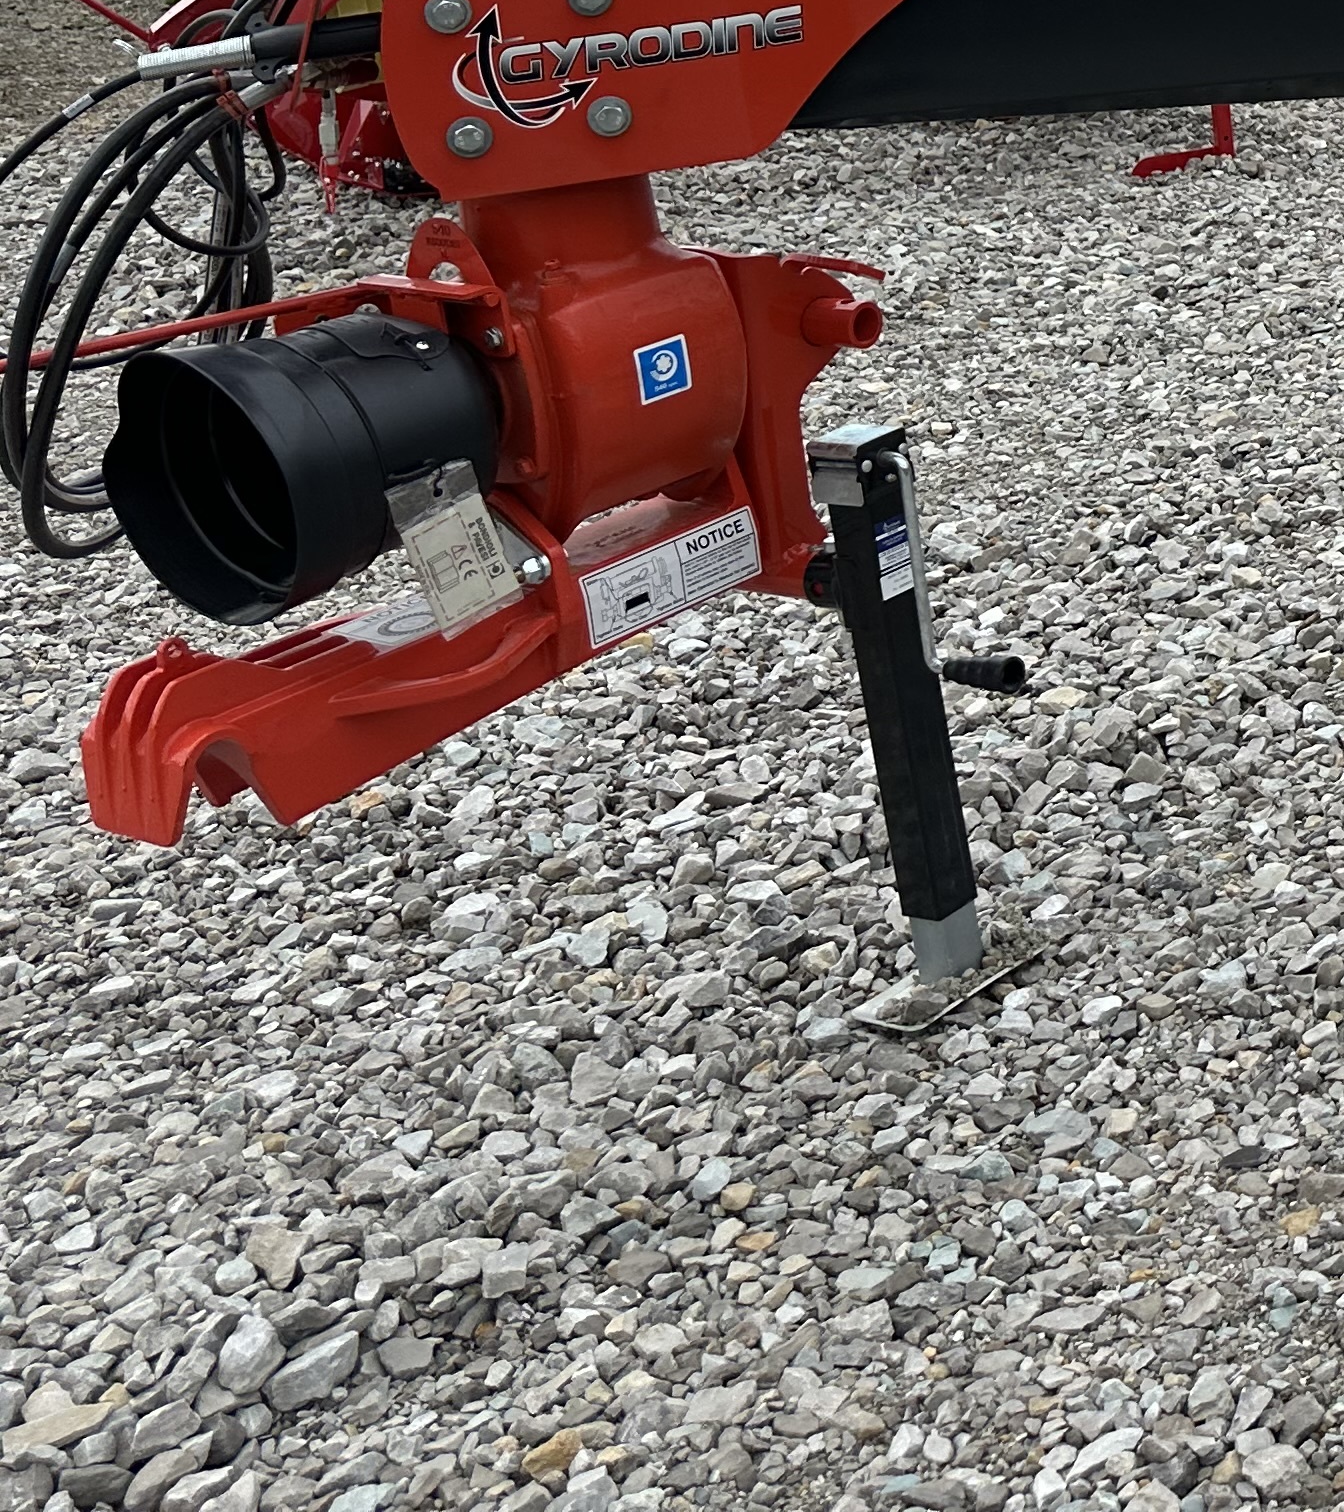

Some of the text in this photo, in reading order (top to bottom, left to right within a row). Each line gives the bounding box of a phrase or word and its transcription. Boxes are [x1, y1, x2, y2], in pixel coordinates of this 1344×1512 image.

[499, 5, 804, 84] GYRODINE
[467, 521, 491, 562] & PAVESI
[474, 516, 498, 558] BONDIOLI
[686, 519, 745, 555] NOTICE
